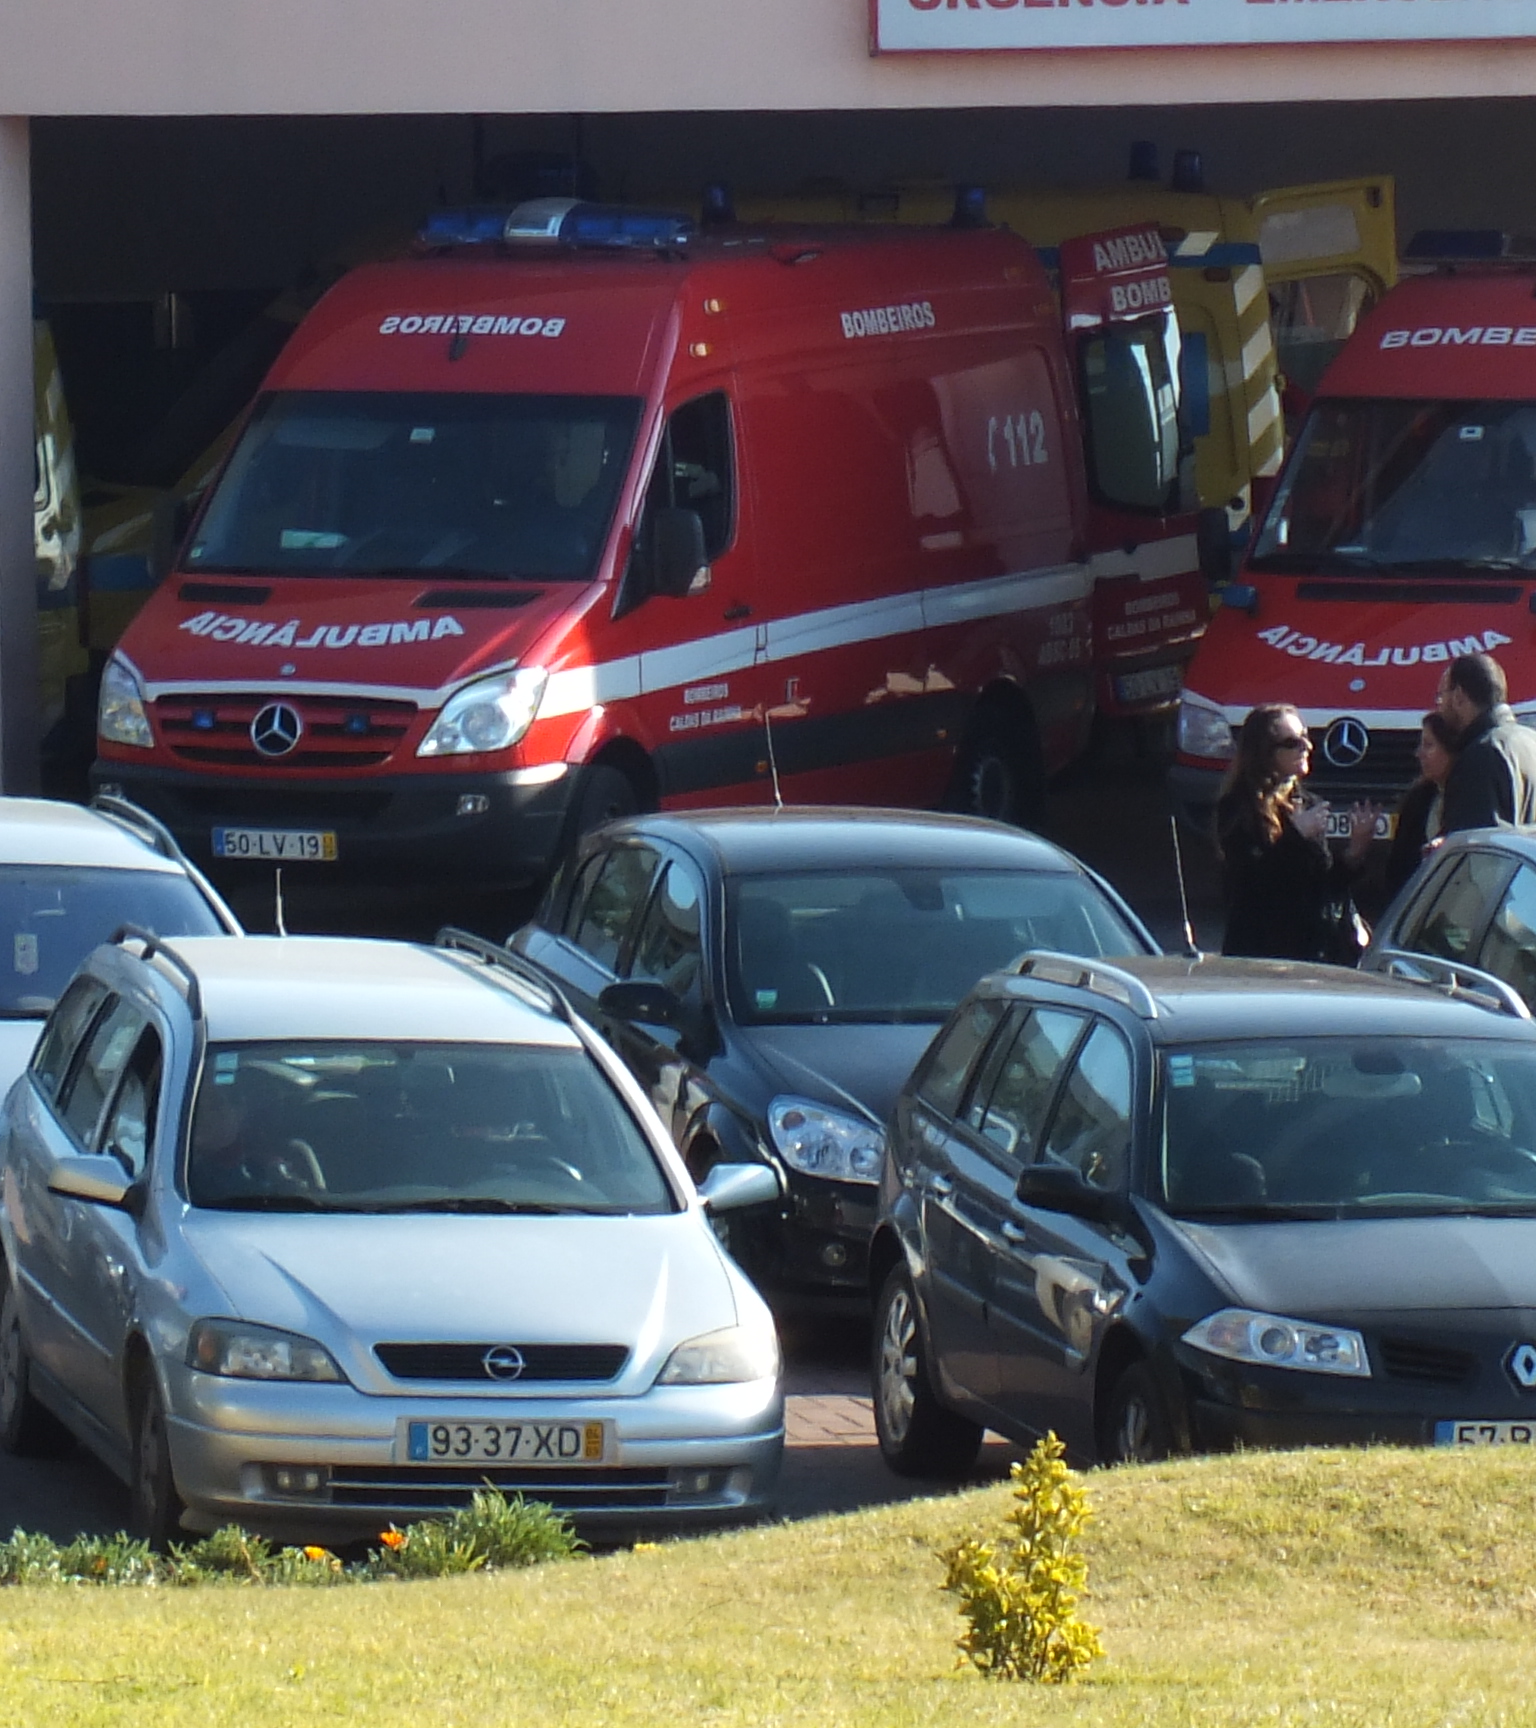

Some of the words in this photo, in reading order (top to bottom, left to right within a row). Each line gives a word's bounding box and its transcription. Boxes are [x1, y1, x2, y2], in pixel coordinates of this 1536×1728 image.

[1111, 275, 1172, 312] BOMB
[840, 300, 936, 340] BOMBEIROS
[1003, 409, 1049, 468] 112
